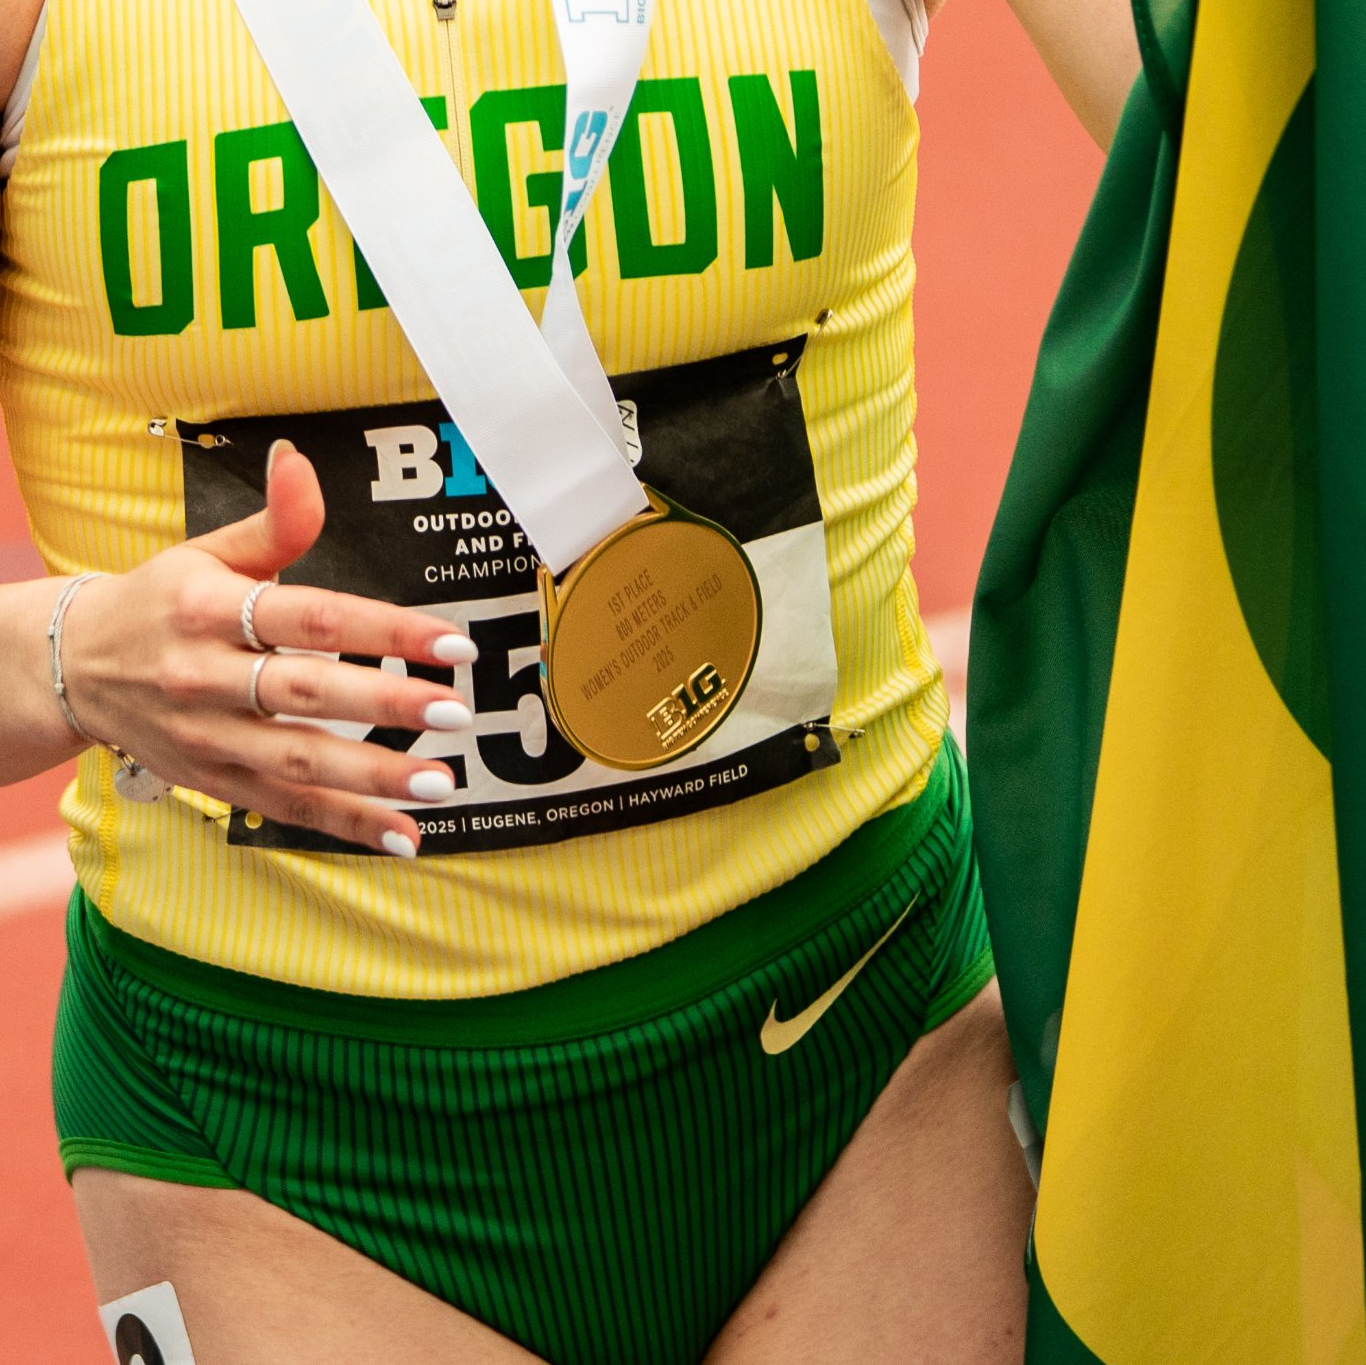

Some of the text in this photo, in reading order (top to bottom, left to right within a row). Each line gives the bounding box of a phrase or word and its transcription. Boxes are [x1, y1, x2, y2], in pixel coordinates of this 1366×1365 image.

[99, 70, 823, 336] ORGON
[455, 535, 503, 555] AND
[608, 568, 654, 616] 1ST PLACE
[632, 589, 667, 625] METERS
[581, 659, 622, 701] WOMEN'S
[620, 625, 663, 668] OUTDOOR
[659, 601, 691, 634] TRACK
[695, 574, 723, 605] FIELD
[419, 820, 456, 834] 2025
[472, 812, 541, 831] EUGENE,
[546, 800, 614, 821] OREGON
[629, 779, 705, 807] HAYWARD
[710, 764, 749, 787] FIELD
